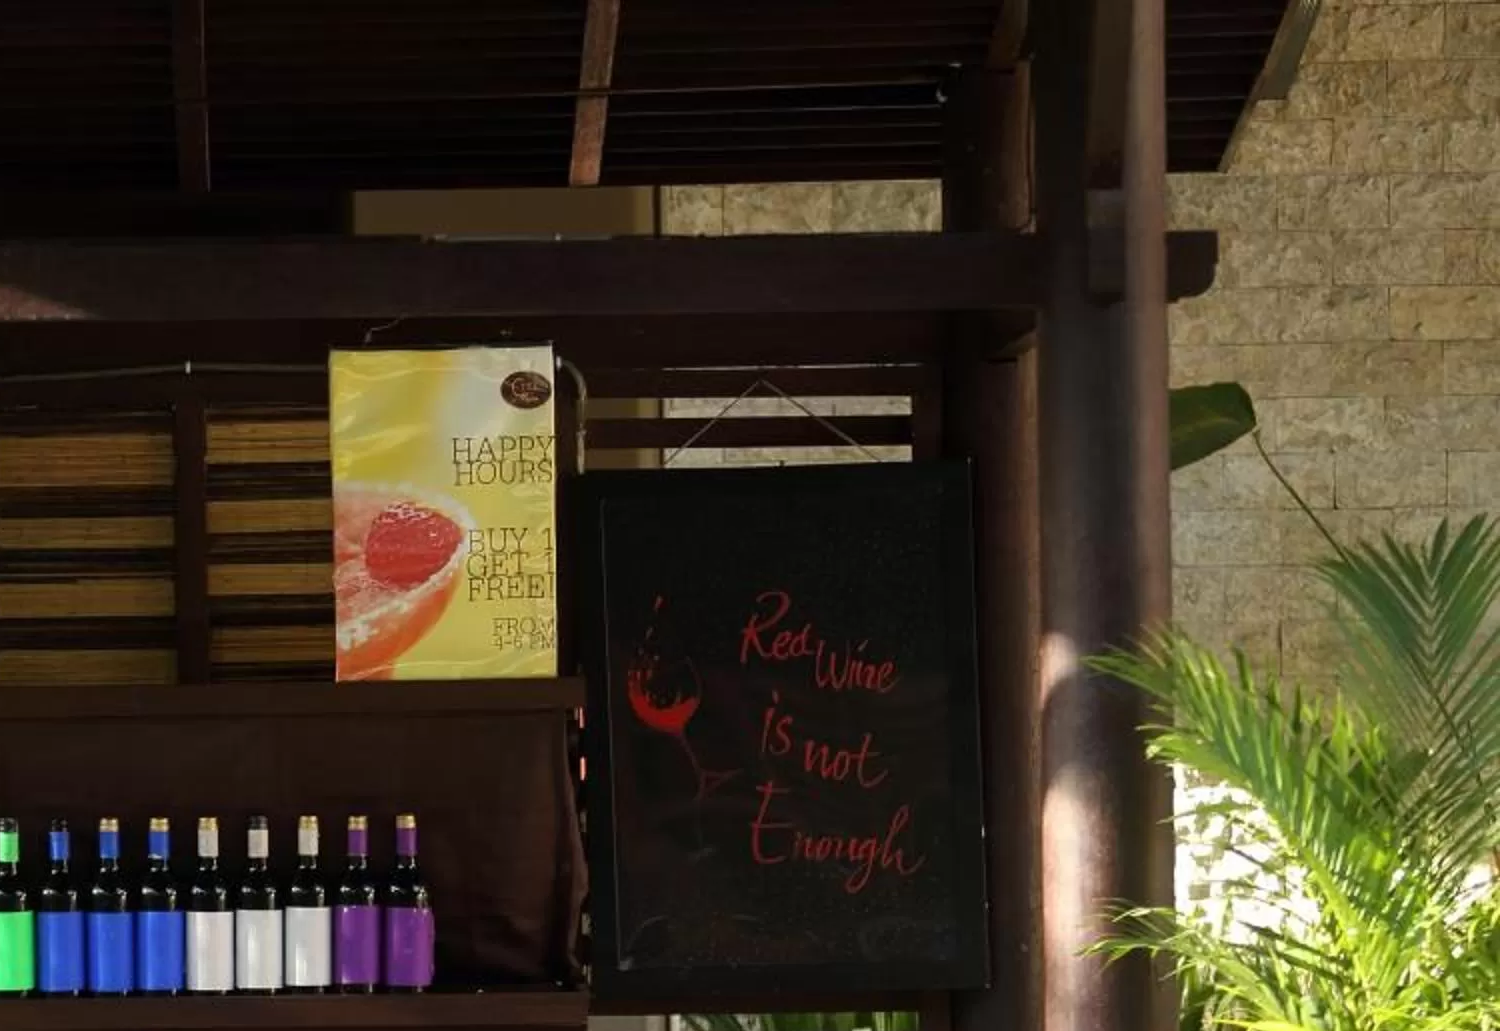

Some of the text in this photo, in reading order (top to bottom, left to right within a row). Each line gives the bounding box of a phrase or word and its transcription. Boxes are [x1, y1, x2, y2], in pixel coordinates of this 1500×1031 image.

[451, 434, 555, 465] HAPPY
[454, 459, 553, 487] HOURS
[467, 527, 554, 554] BUY 1
[466, 550, 554, 577] GET 1
[491, 616, 554, 637] FROM
[740, 591, 816, 664] Red
[761, 690, 889, 787] is not
[749, 780, 925, 894] Enough
